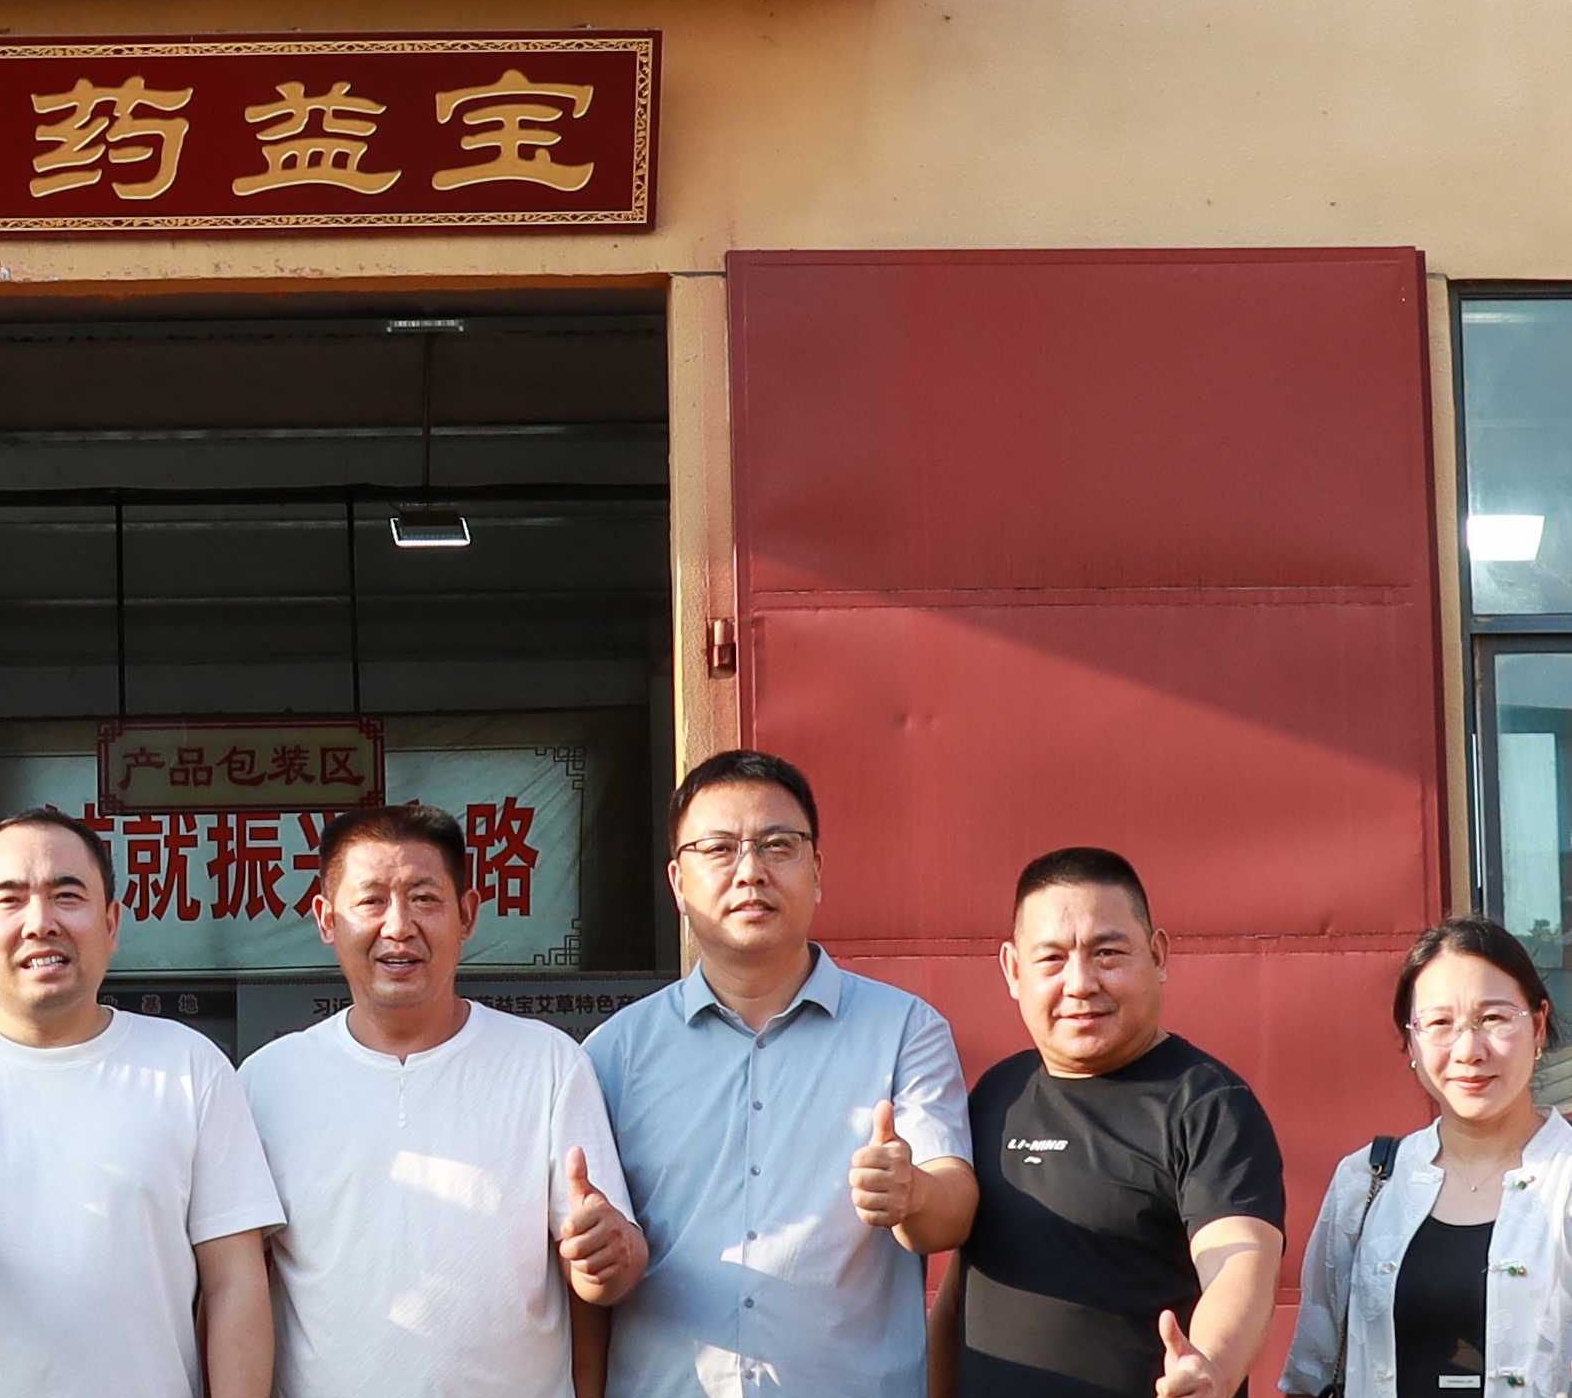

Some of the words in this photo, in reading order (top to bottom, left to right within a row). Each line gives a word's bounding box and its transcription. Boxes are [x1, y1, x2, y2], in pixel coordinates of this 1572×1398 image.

[118, 745, 366, 790] 产品包装区
